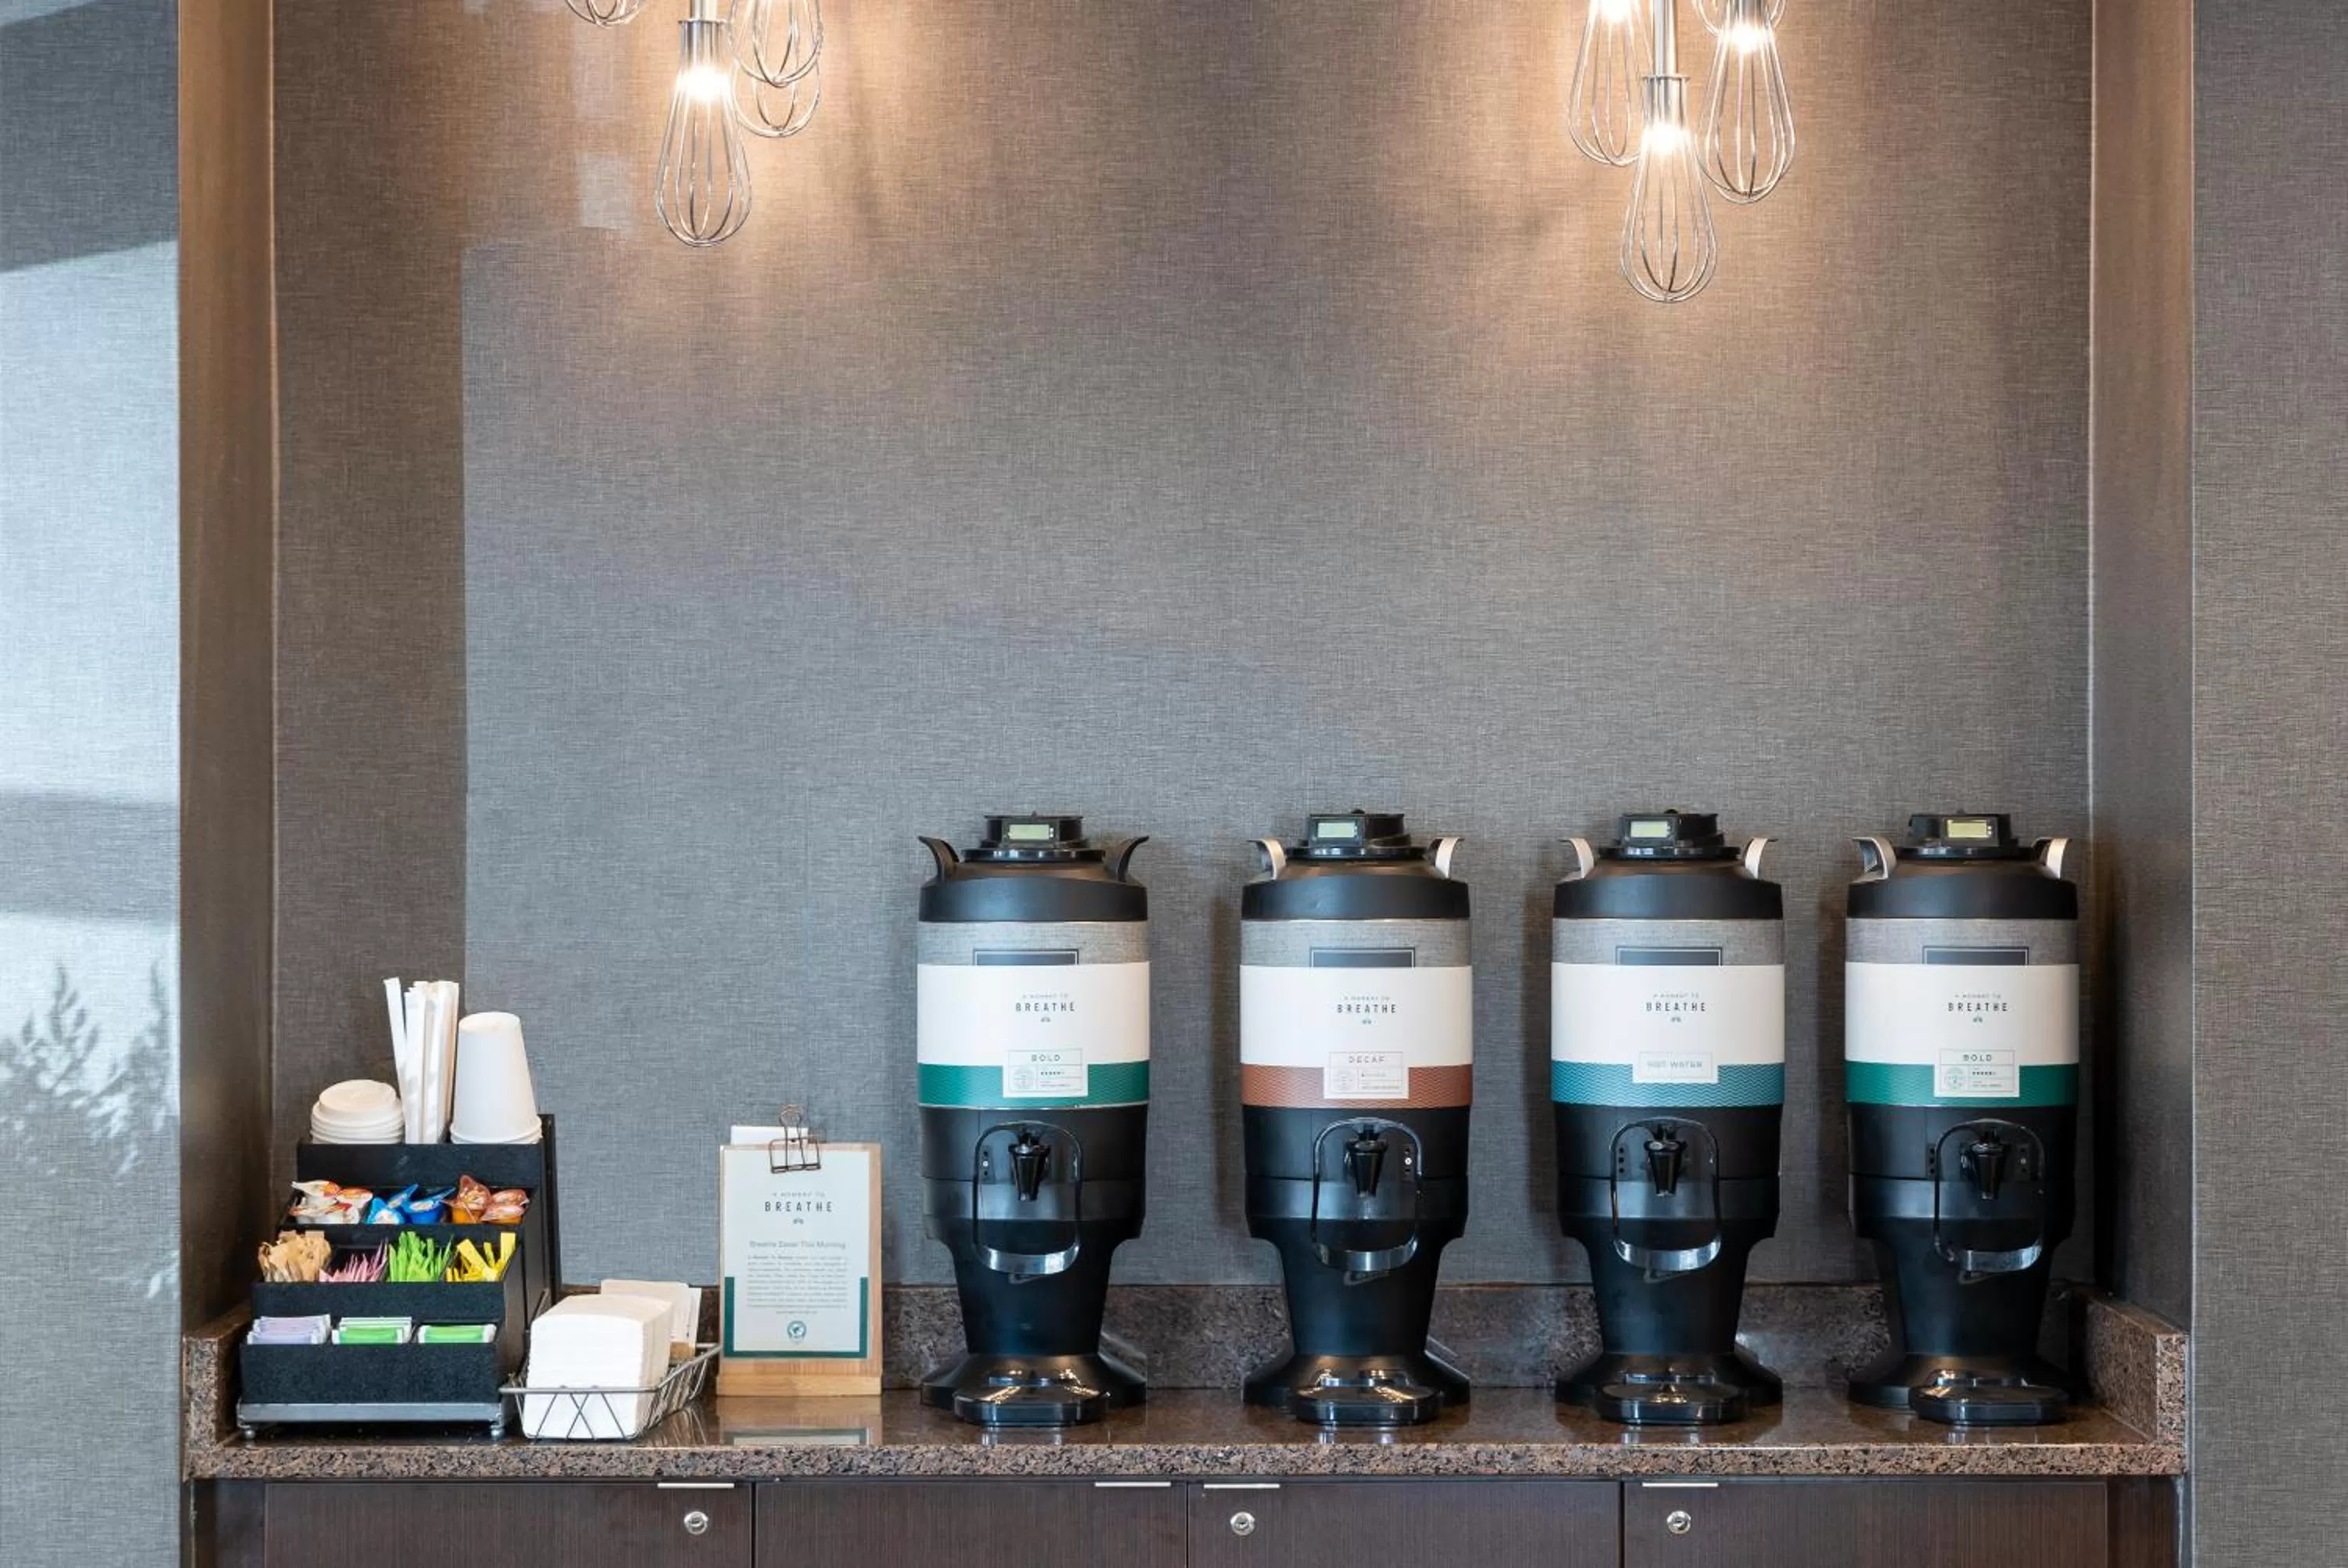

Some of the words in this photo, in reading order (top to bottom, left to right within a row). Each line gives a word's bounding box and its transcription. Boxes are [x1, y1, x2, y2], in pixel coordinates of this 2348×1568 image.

[1015, 1002, 1075, 1012] BREATHE
[1337, 1004, 1396, 1013] BREATHE
[1646, 1002, 1706, 1012] BREATHE
[1948, 1002, 2008, 1012] BREATHE
[765, 1201, 832, 1212] BREATHE
